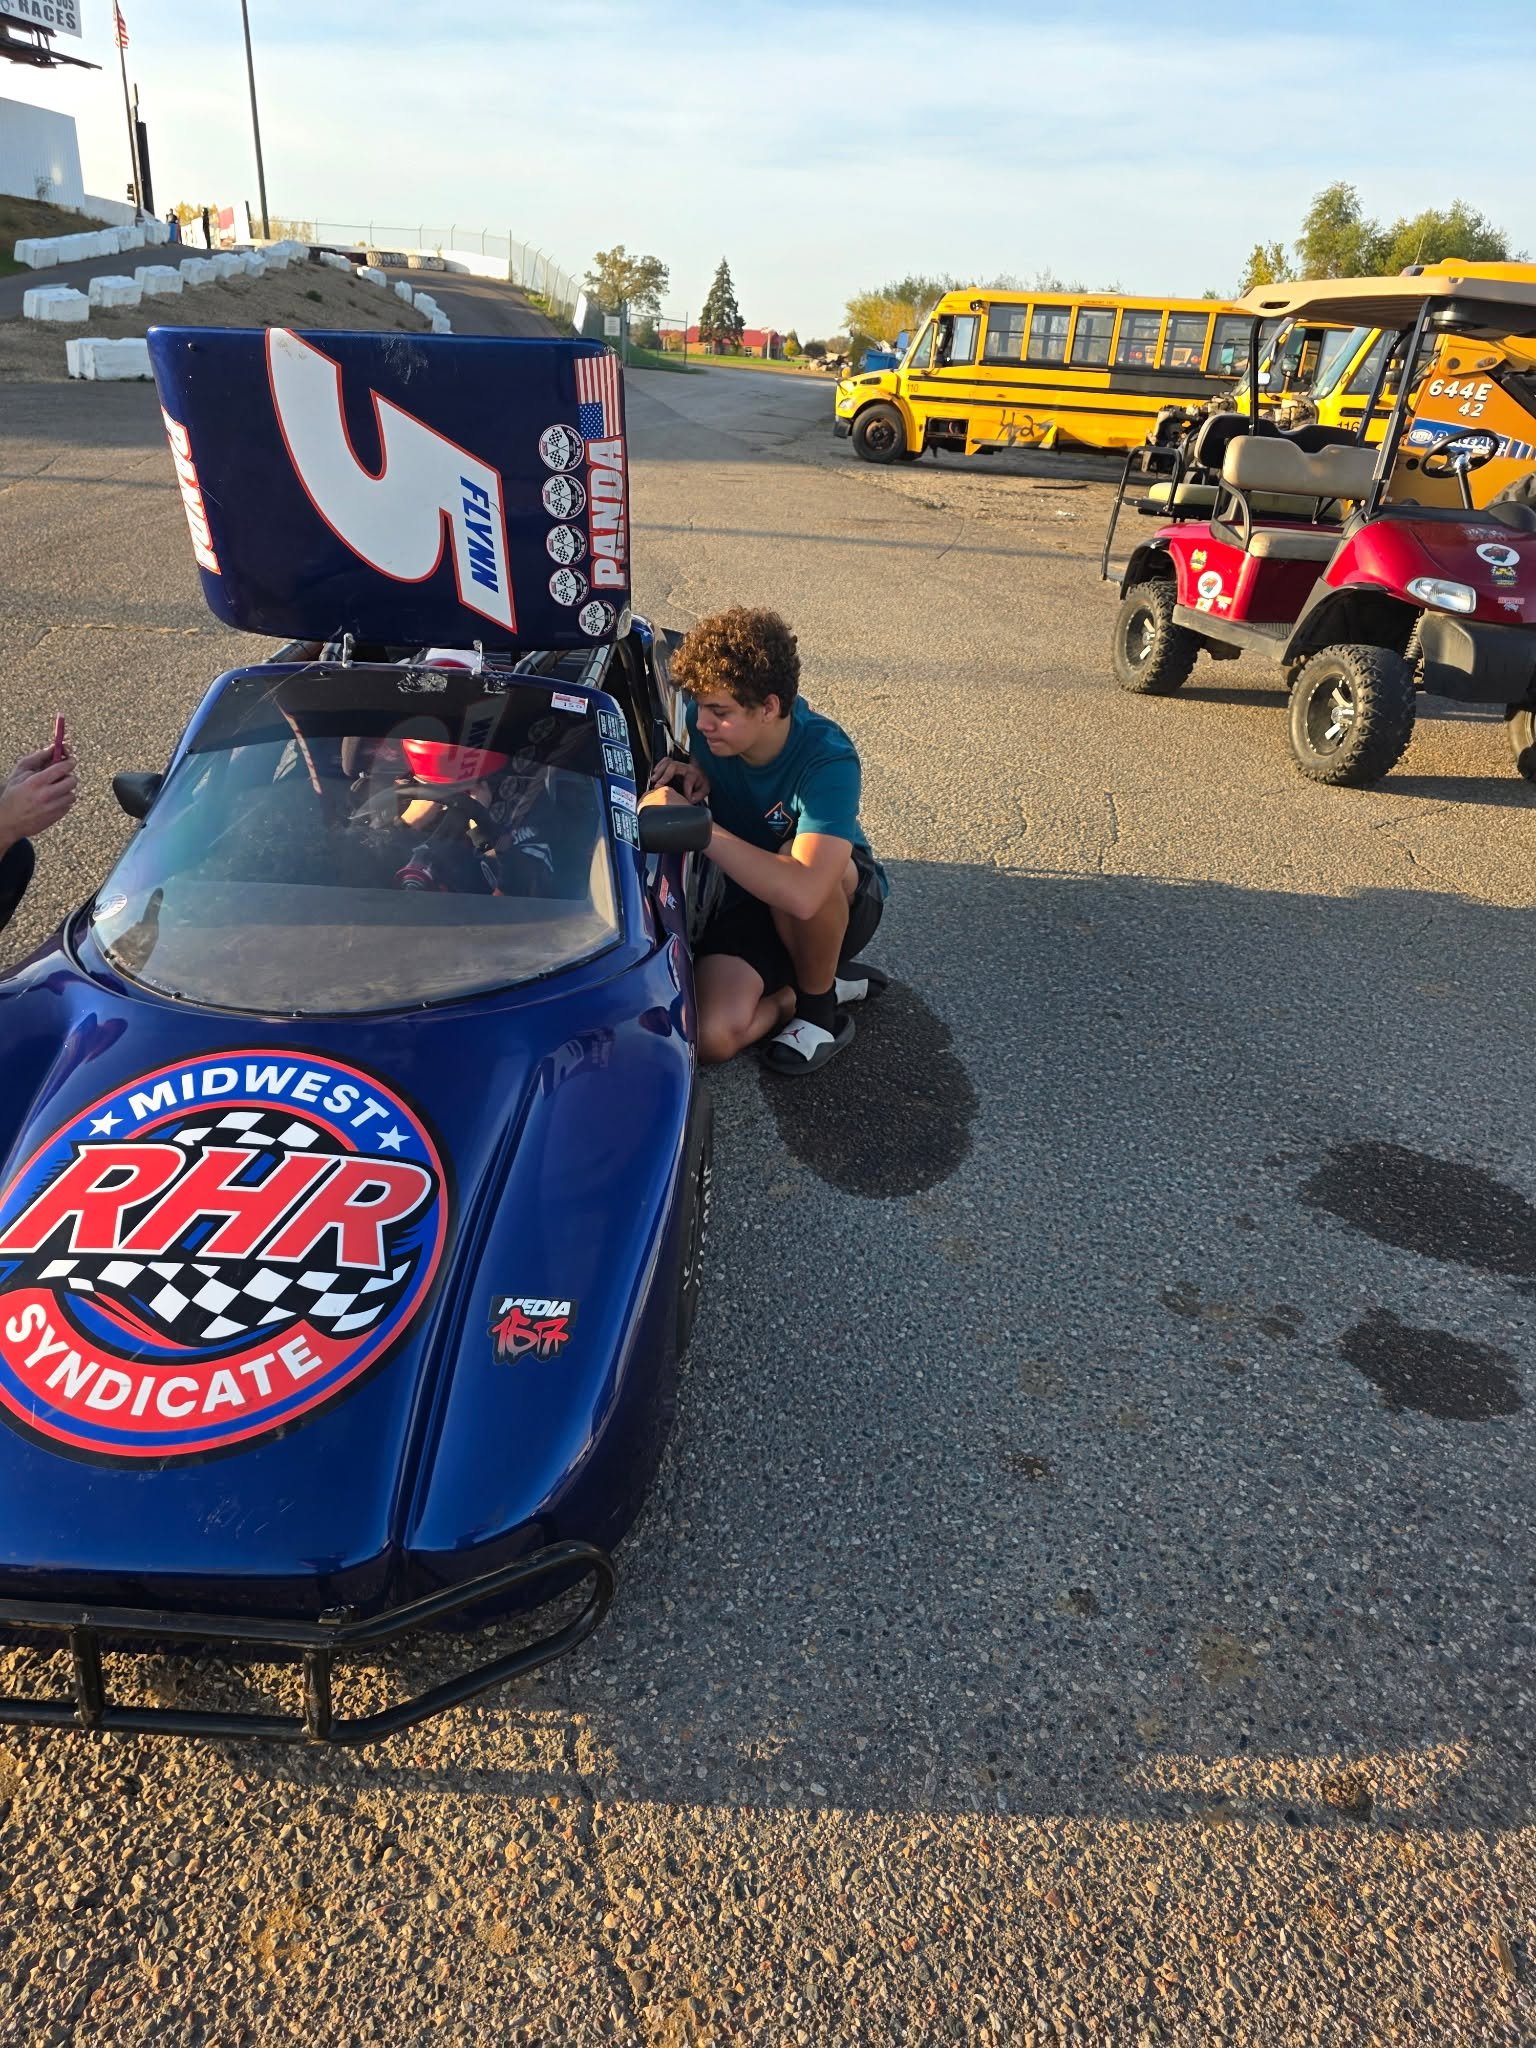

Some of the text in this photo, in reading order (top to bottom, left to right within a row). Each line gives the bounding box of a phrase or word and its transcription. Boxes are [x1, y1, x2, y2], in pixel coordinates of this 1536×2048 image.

[19, 0, 76, 30] RACES
[1428, 379, 1493, 402] 644E
[1458, 401, 1484, 417] 42
[265, 327, 517, 634] 5
[588, 439, 626, 586] PANDA
[460, 475, 499, 593] FLYNN
[128, 1064, 390, 1128] MIDWEST
[0, 1142, 433, 1272] RHR
[498, 1297, 571, 1317] MEDIA
[5, 1303, 323, 1418] SYNDICATE
